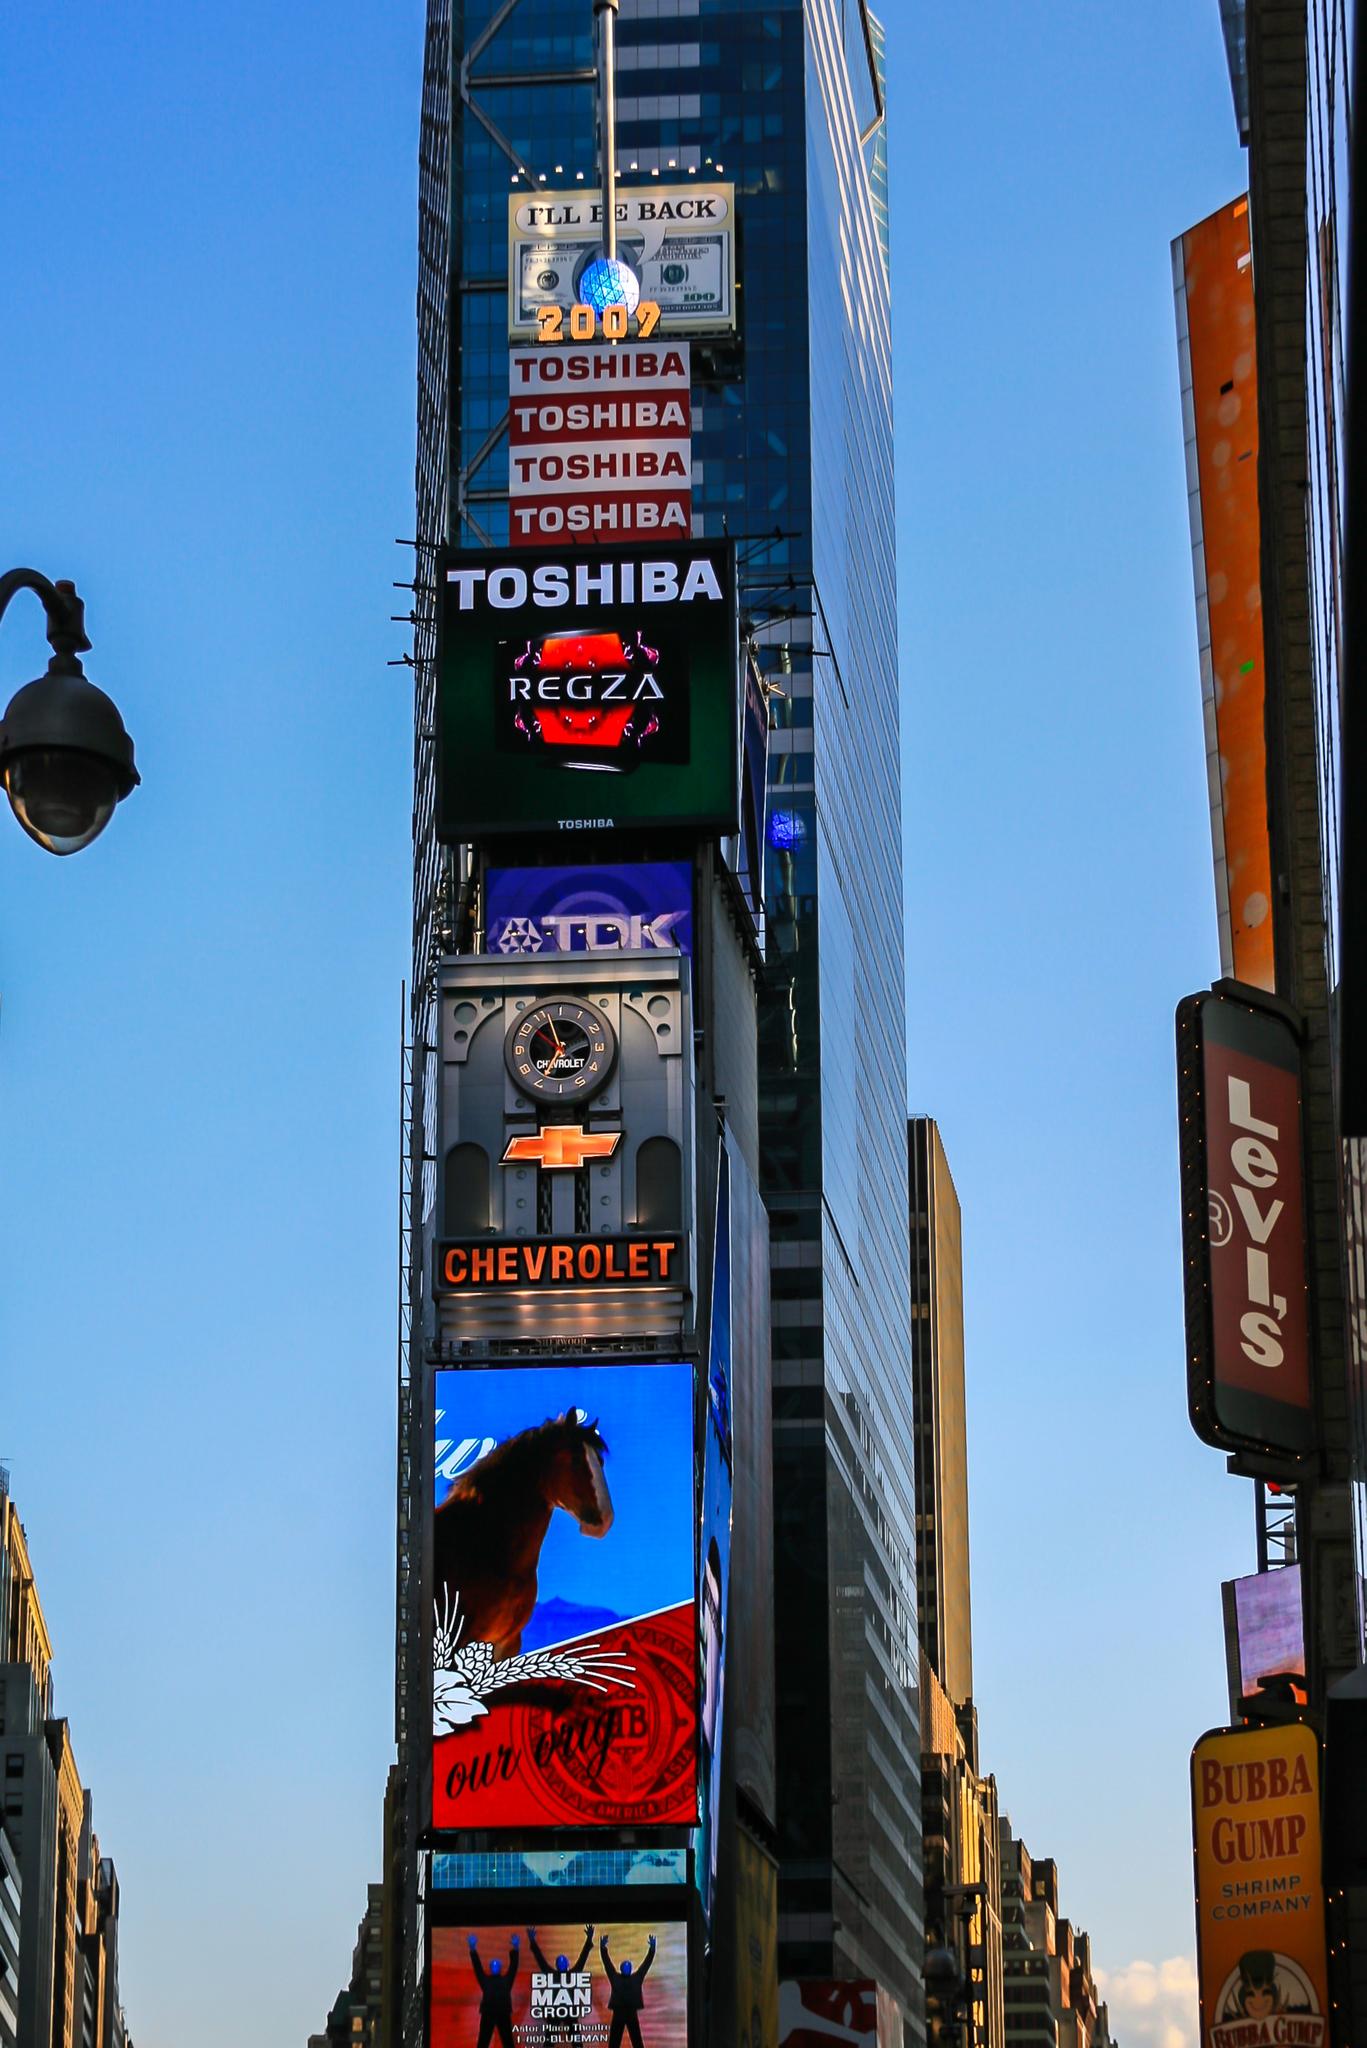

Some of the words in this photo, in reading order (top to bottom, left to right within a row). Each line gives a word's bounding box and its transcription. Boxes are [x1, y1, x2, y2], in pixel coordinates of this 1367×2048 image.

[527, 206, 581, 226] I'LL
[637, 200, 716, 221] BACK
[514, 352, 687, 382] TOSHIBA
[514, 401, 687, 432] TOSHIBA
[514, 452, 687, 482] TOSHIBA
[514, 502, 687, 533] TOSHIBA
[446, 560, 723, 610] TOSHIBA
[509, 673, 665, 701] REGZA
[557, 818, 614, 830] TOSHIBA
[541, 911, 676, 951] TDK
[444, 1242, 675, 1284] CHEVROLET
[446, 1743, 522, 1800] our
[1201, 1753, 1314, 1808] BUBBA
[1211, 1814, 1307, 1865] GUMP
[1222, 1875, 1302, 1898] SHRIMP
[1212, 1896, 1312, 1921] COMPANY
[531, 1973, 591, 1989] BLUE
[531, 1988, 591, 2006] MAN
[531, 2006, 591, 2018] GROUP
[1214, 2021, 1271, 2048] BUBBA
[1273, 2017, 1323, 2046] GUMP
